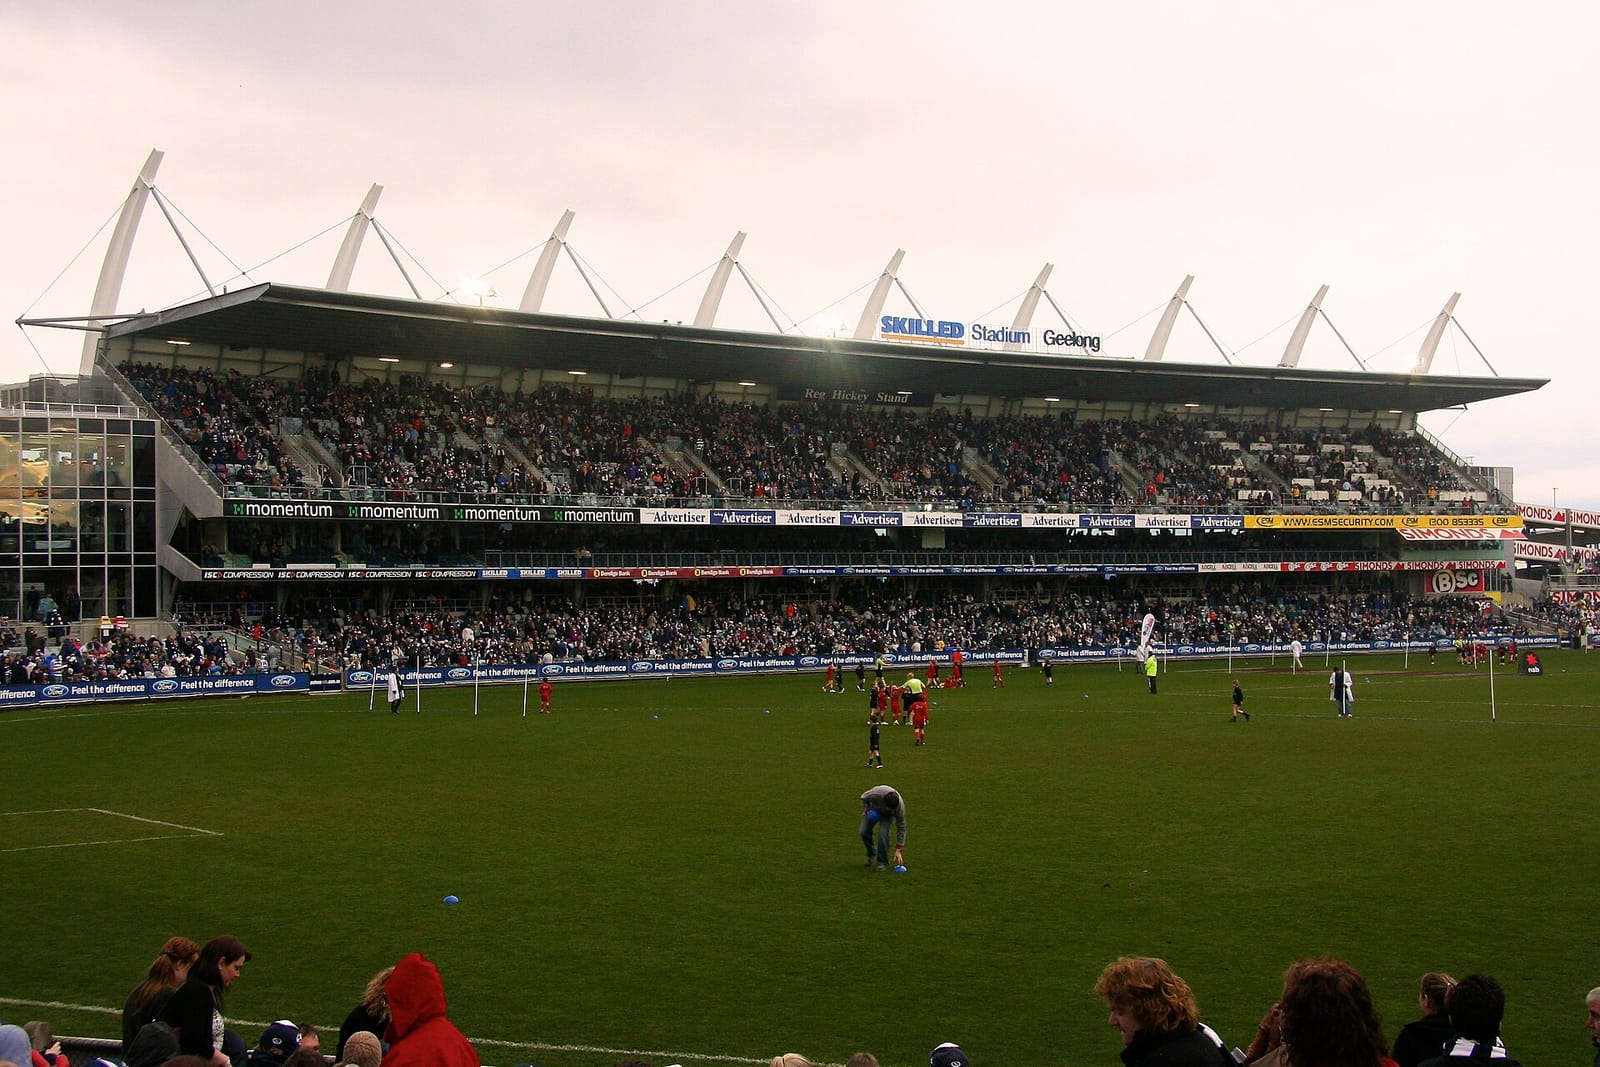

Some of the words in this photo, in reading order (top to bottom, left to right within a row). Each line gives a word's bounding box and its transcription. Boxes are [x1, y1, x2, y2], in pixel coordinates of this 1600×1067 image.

[881, 315, 965, 339] SKILLED
[972, 324, 1031, 344] Stadium
[1043, 330, 1101, 351] Geelong
[805, 388, 825, 400] Reg
[832, 389, 869, 402] Hickey
[877, 391, 909, 404] Stand
[246, 503, 333, 517] momentum
[360, 504, 440, 519] momentum
[465, 507, 541, 521] momentum
[564, 509, 634, 523] momentum
[654, 511, 706, 522] Advertiser
[722, 512, 772, 523] Advertiser
[788, 513, 836, 524] Advertiser
[1517, 505, 1552, 521] MONDS
[851, 513, 899, 525] Advertiser
[914, 514, 958, 526] Advertiser
[973, 515, 1019, 526] Advertiser
[1032, 515, 1076, 526] Advertiser
[1089, 516, 1132, 527] Advertiser
[1145, 517, 1188, 527] Advertiser
[1200, 517, 1242, 528] Advertiser
[1399, 528, 1496, 539] SIMONDS
[1354, 561, 1393, 570] SIMONDS
[1407, 561, 1445, 569] SIMONDS
[1459, 560, 1495, 569] SIMONDS
[204, 571, 218, 579] ISC
[223, 571, 275, 579] COMPRESSION
[278, 571, 291, 579] ISC
[431, 570, 476, 578] COMPRESSION
[593, 664, 627, 672] difference
[669, 662, 681, 670] the
[739, 660, 753, 668] Feel
[405, 672, 442, 680] difference
[473, 669, 488, 677] Feel
[71, 685, 88, 694] Feel
[89, 685, 104, 694] the
[105, 684, 145, 693] difference
[180, 681, 198, 690] Feel
[198, 680, 213, 689] the
[214, 679, 254, 688] difference
[0, 690, 36, 699] ifference
